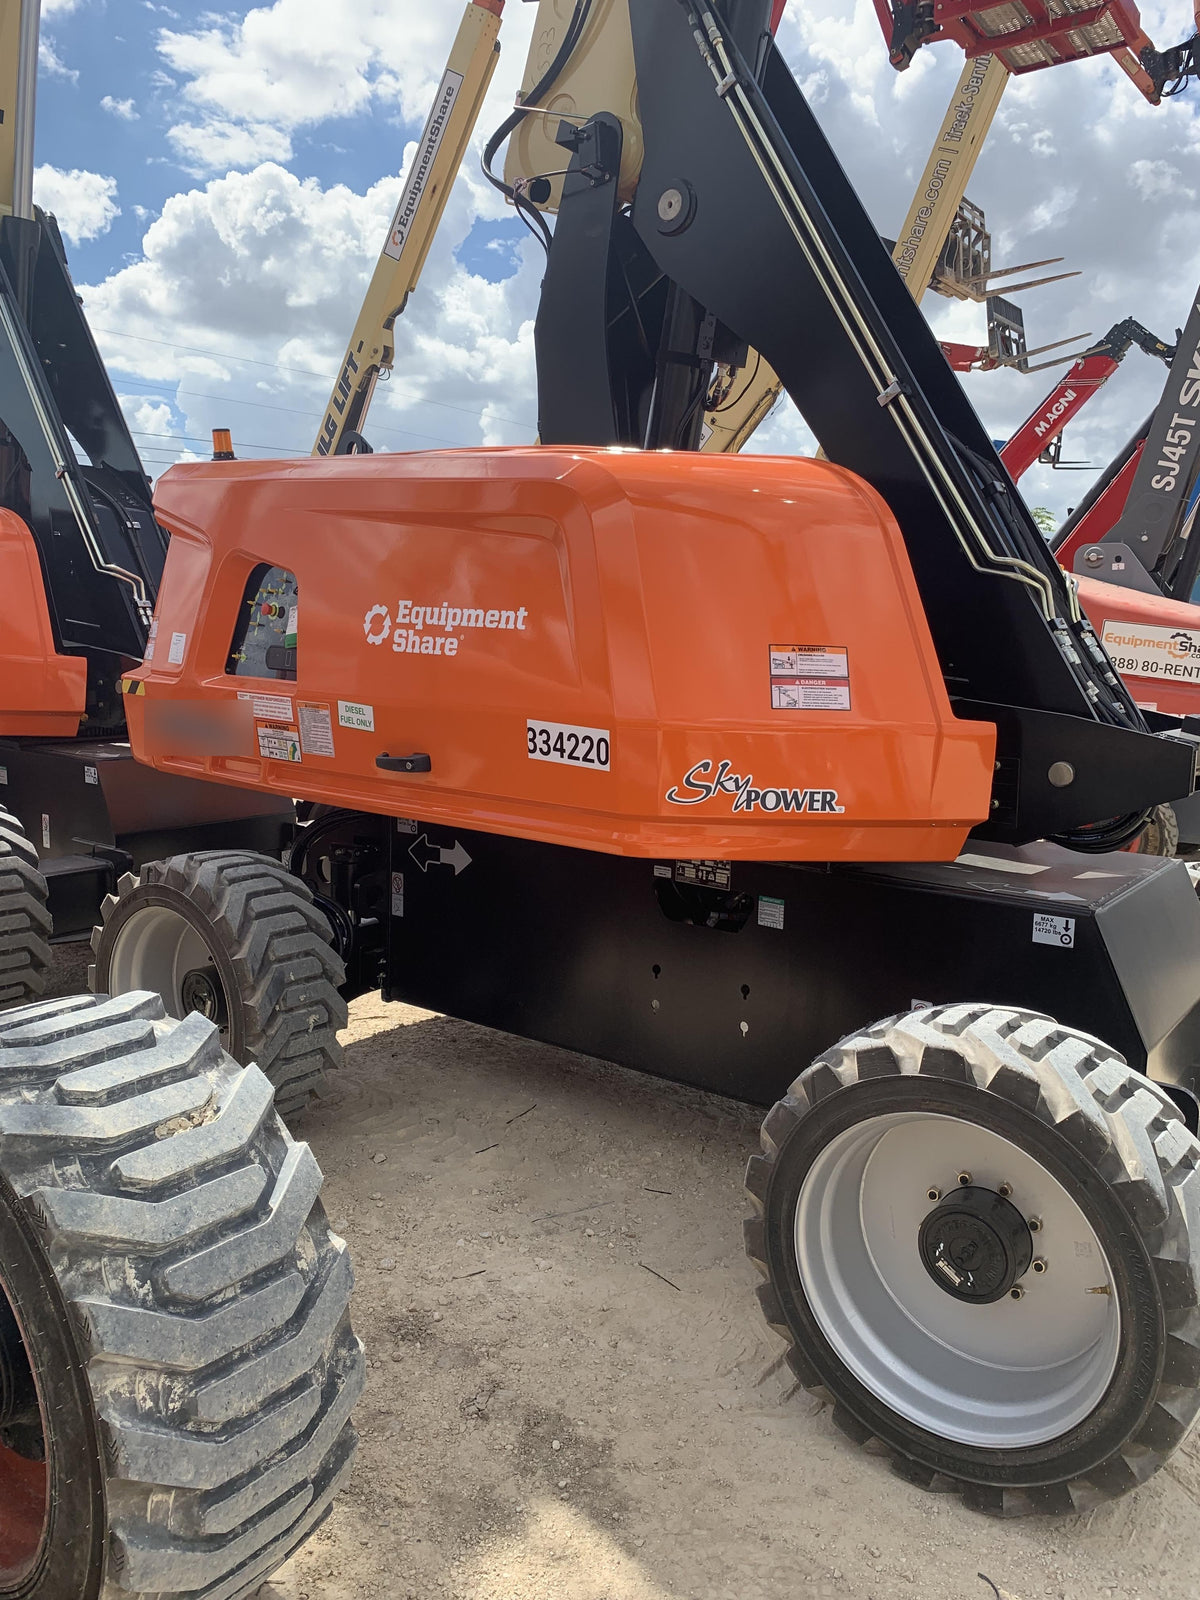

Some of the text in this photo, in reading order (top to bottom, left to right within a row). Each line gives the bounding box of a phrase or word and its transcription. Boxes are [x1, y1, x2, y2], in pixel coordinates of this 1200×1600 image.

[398, 86, 455, 229] EquipmentShare
[333, 350, 359, 416] LIFT
[1034, 389, 1077, 437] MAGNI
[1151, 413, 1196, 491] SJ45T
[396, 600, 528, 631] Equipment
[392, 629, 458, 656] Share
[269, 724, 289, 732] WARNING
[340, 715, 372, 728] FUEL ONLY
[344, 705, 366, 716] DIESEL
[527, 726, 609, 766] 334220
